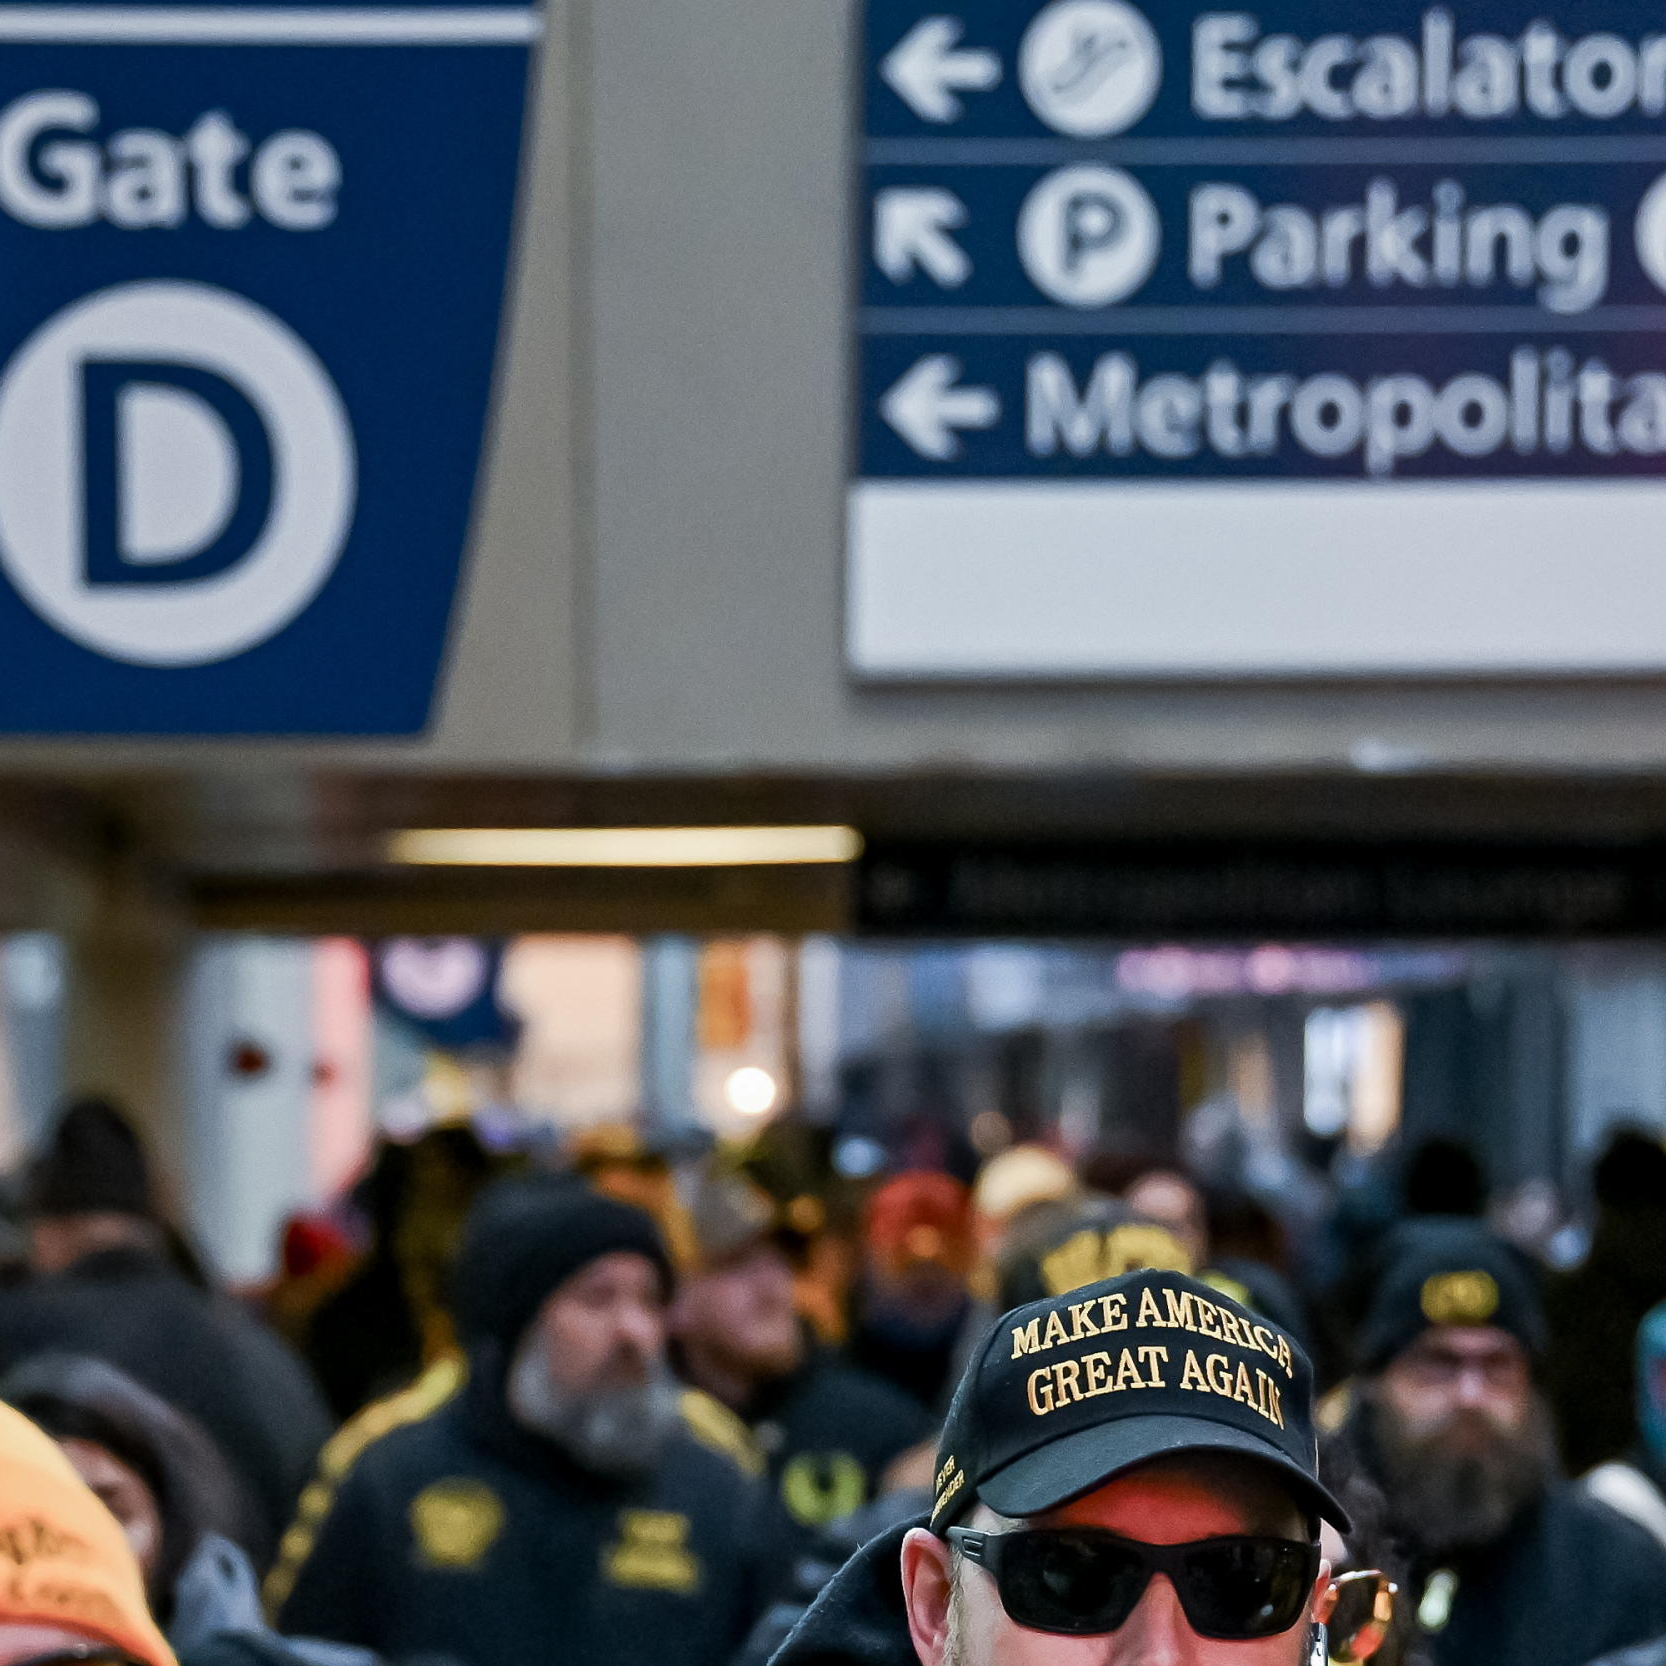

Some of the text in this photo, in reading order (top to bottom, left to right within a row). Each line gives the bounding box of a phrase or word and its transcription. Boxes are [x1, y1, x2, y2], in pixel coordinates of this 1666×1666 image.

[1188, 176, 1610, 314] Parking
[81, 359, 275, 586] D
[1010, 1286, 1293, 1380] MAKE AMERICA
[1025, 1345, 1285, 1431] GREAT AGAIN
